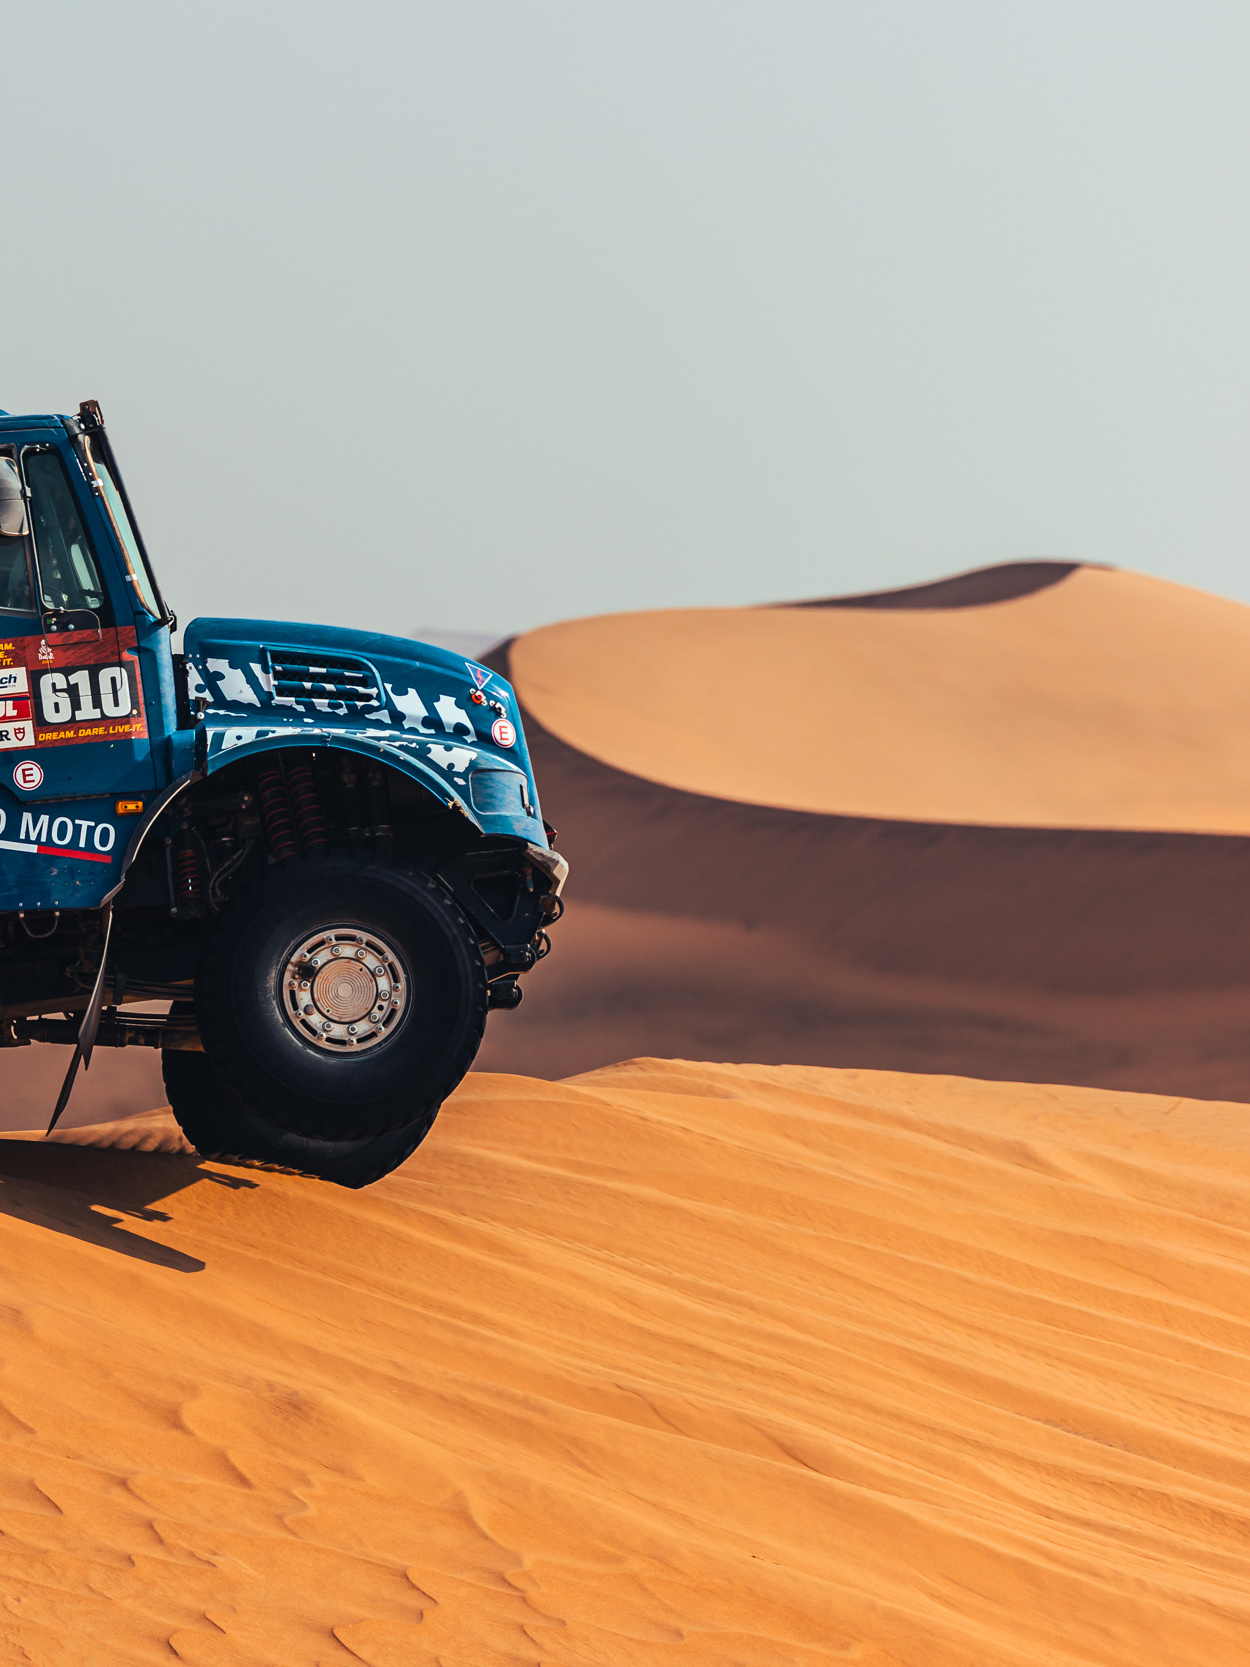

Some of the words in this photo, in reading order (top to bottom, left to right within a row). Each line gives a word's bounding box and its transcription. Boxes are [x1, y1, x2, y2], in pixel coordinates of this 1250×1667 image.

[1, 658, 14, 667] IT.
[40, 666, 132, 723] 610
[38, 730, 77, 742] DREAM.
[78, 727, 108, 737] DARE.
[109, 725, 131, 734] LIVE
[131, 723, 143, 732] IT.
[498, 725, 510, 741] E
[21, 767, 35, 784] E
[19, 811, 116, 852] MOTO
